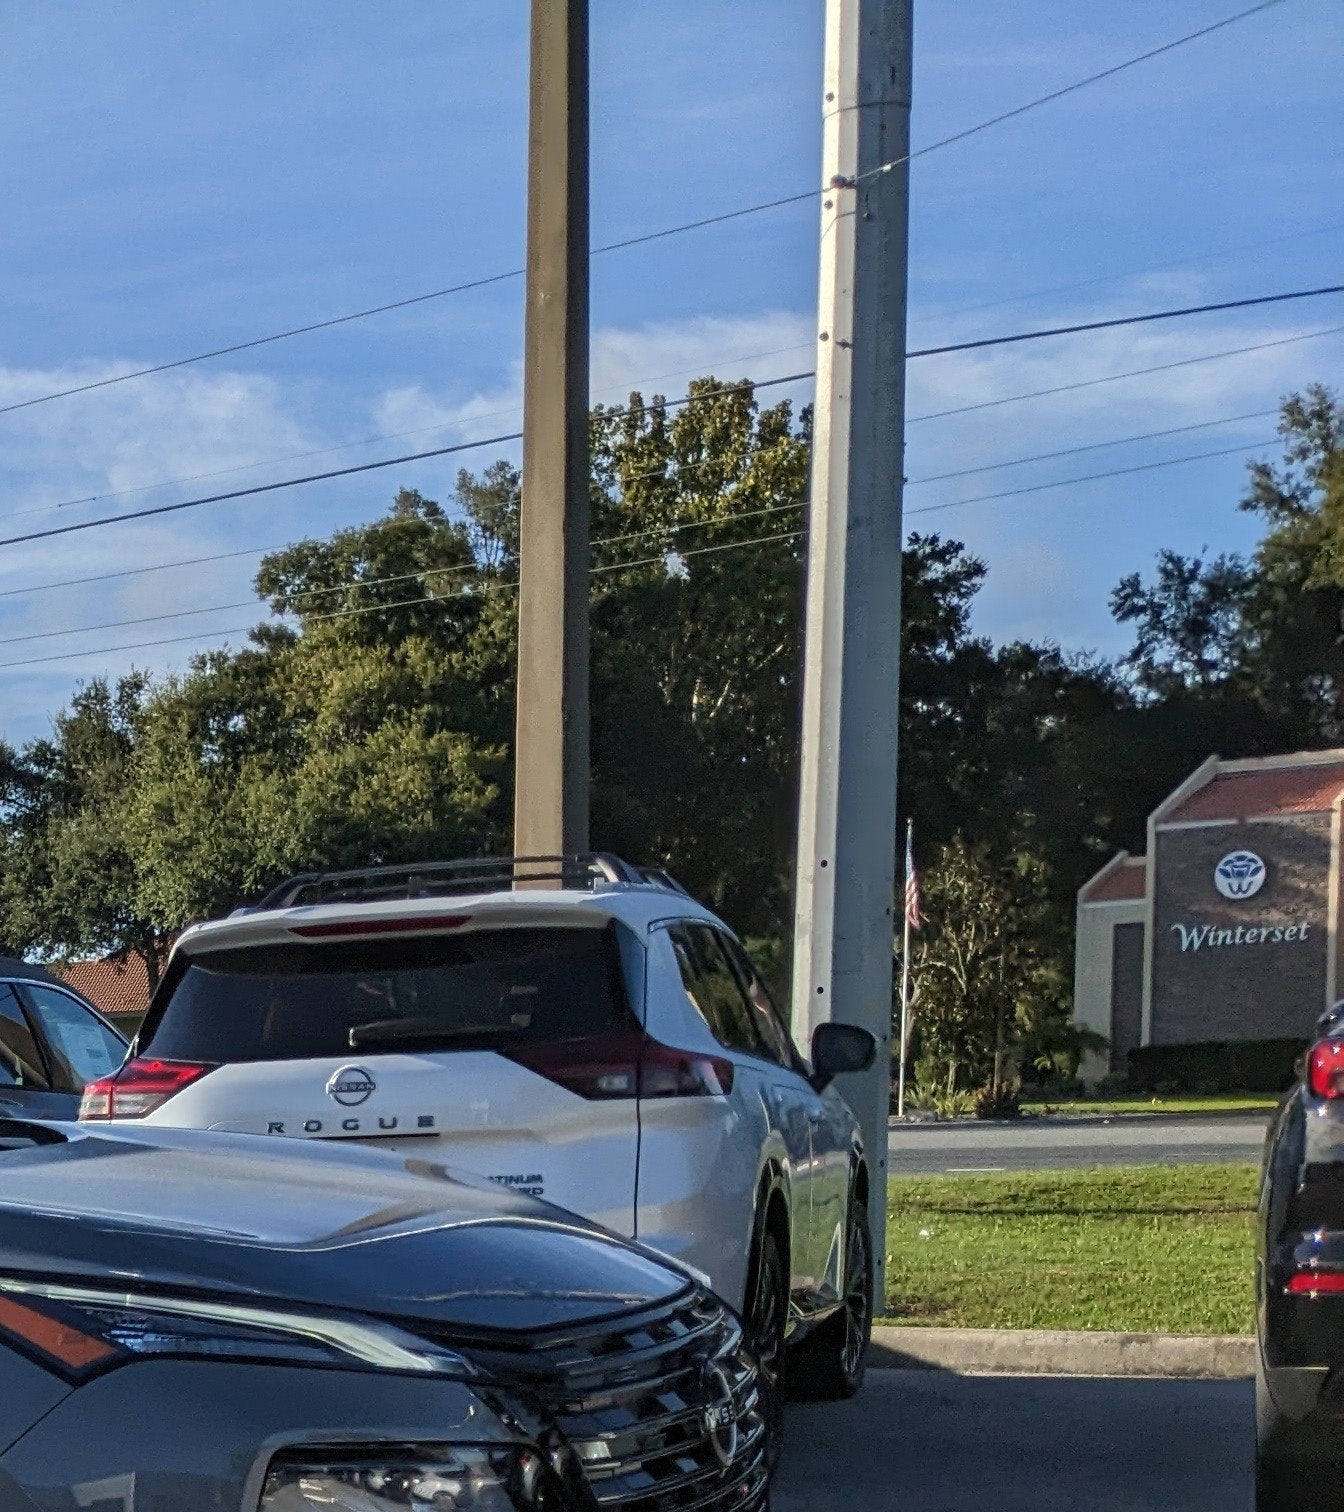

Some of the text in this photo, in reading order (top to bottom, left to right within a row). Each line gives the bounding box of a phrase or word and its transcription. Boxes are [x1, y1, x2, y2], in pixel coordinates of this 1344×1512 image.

[1170, 920, 1311, 952] Winterset
[329, 1081, 375, 1093] NISSAN
[267, 1115, 435, 1134] ROGUE
